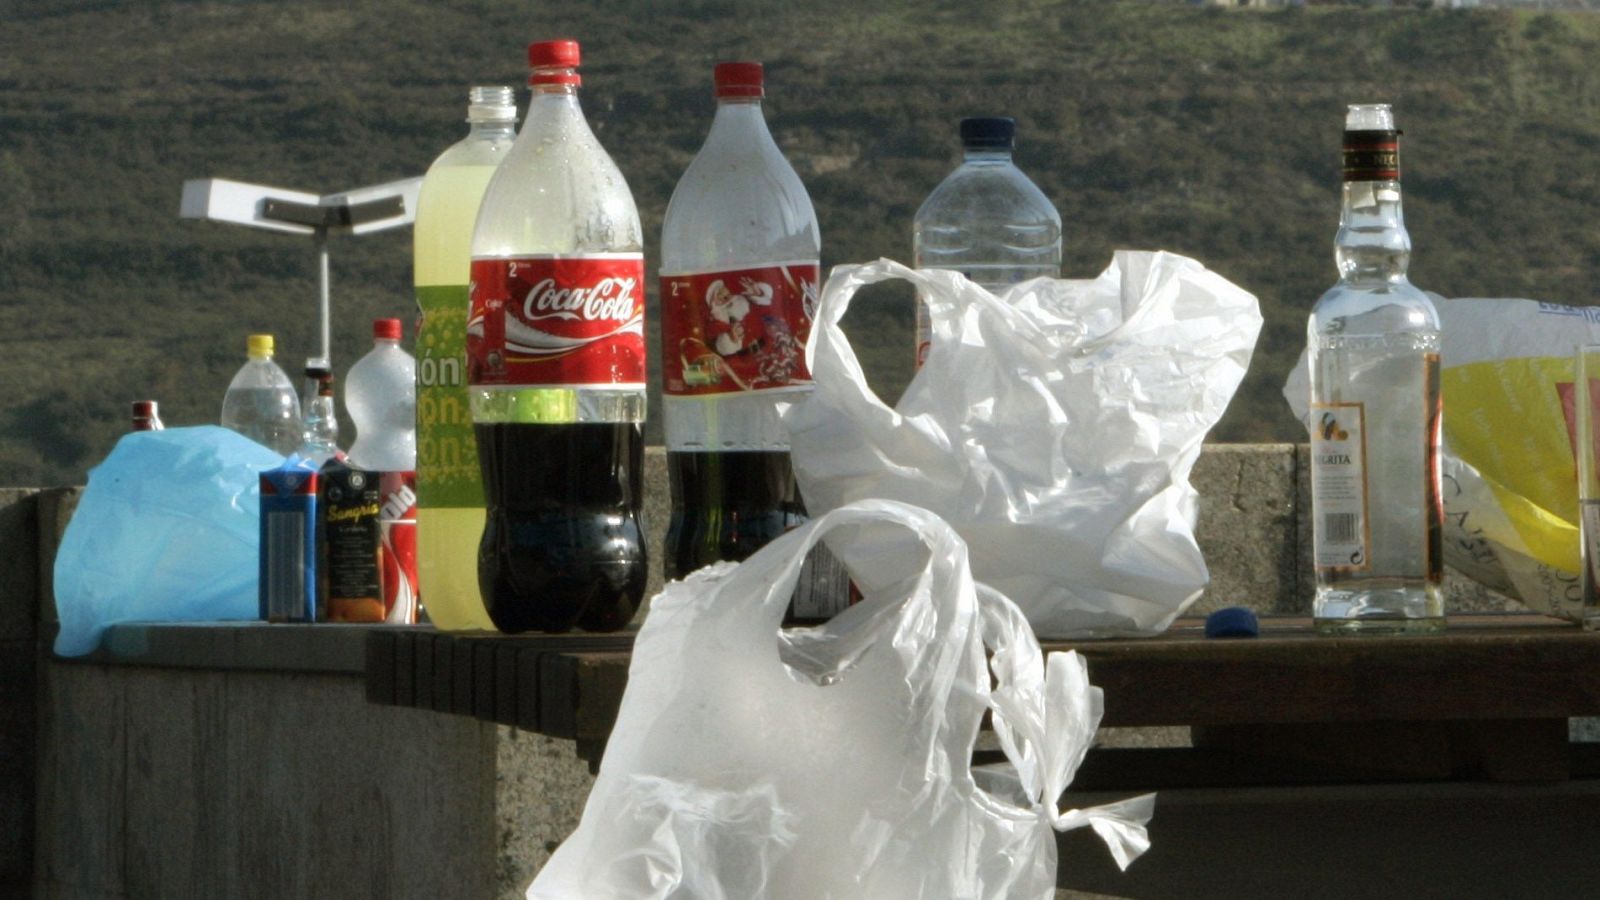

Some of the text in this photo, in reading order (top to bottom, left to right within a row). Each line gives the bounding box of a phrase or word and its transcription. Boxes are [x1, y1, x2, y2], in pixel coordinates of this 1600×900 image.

[509, 262, 518, 278] 2
[523, 277, 637, 321] Coca-Cola
[671, 281, 680, 297] 2
[416, 348, 460, 385] ón
